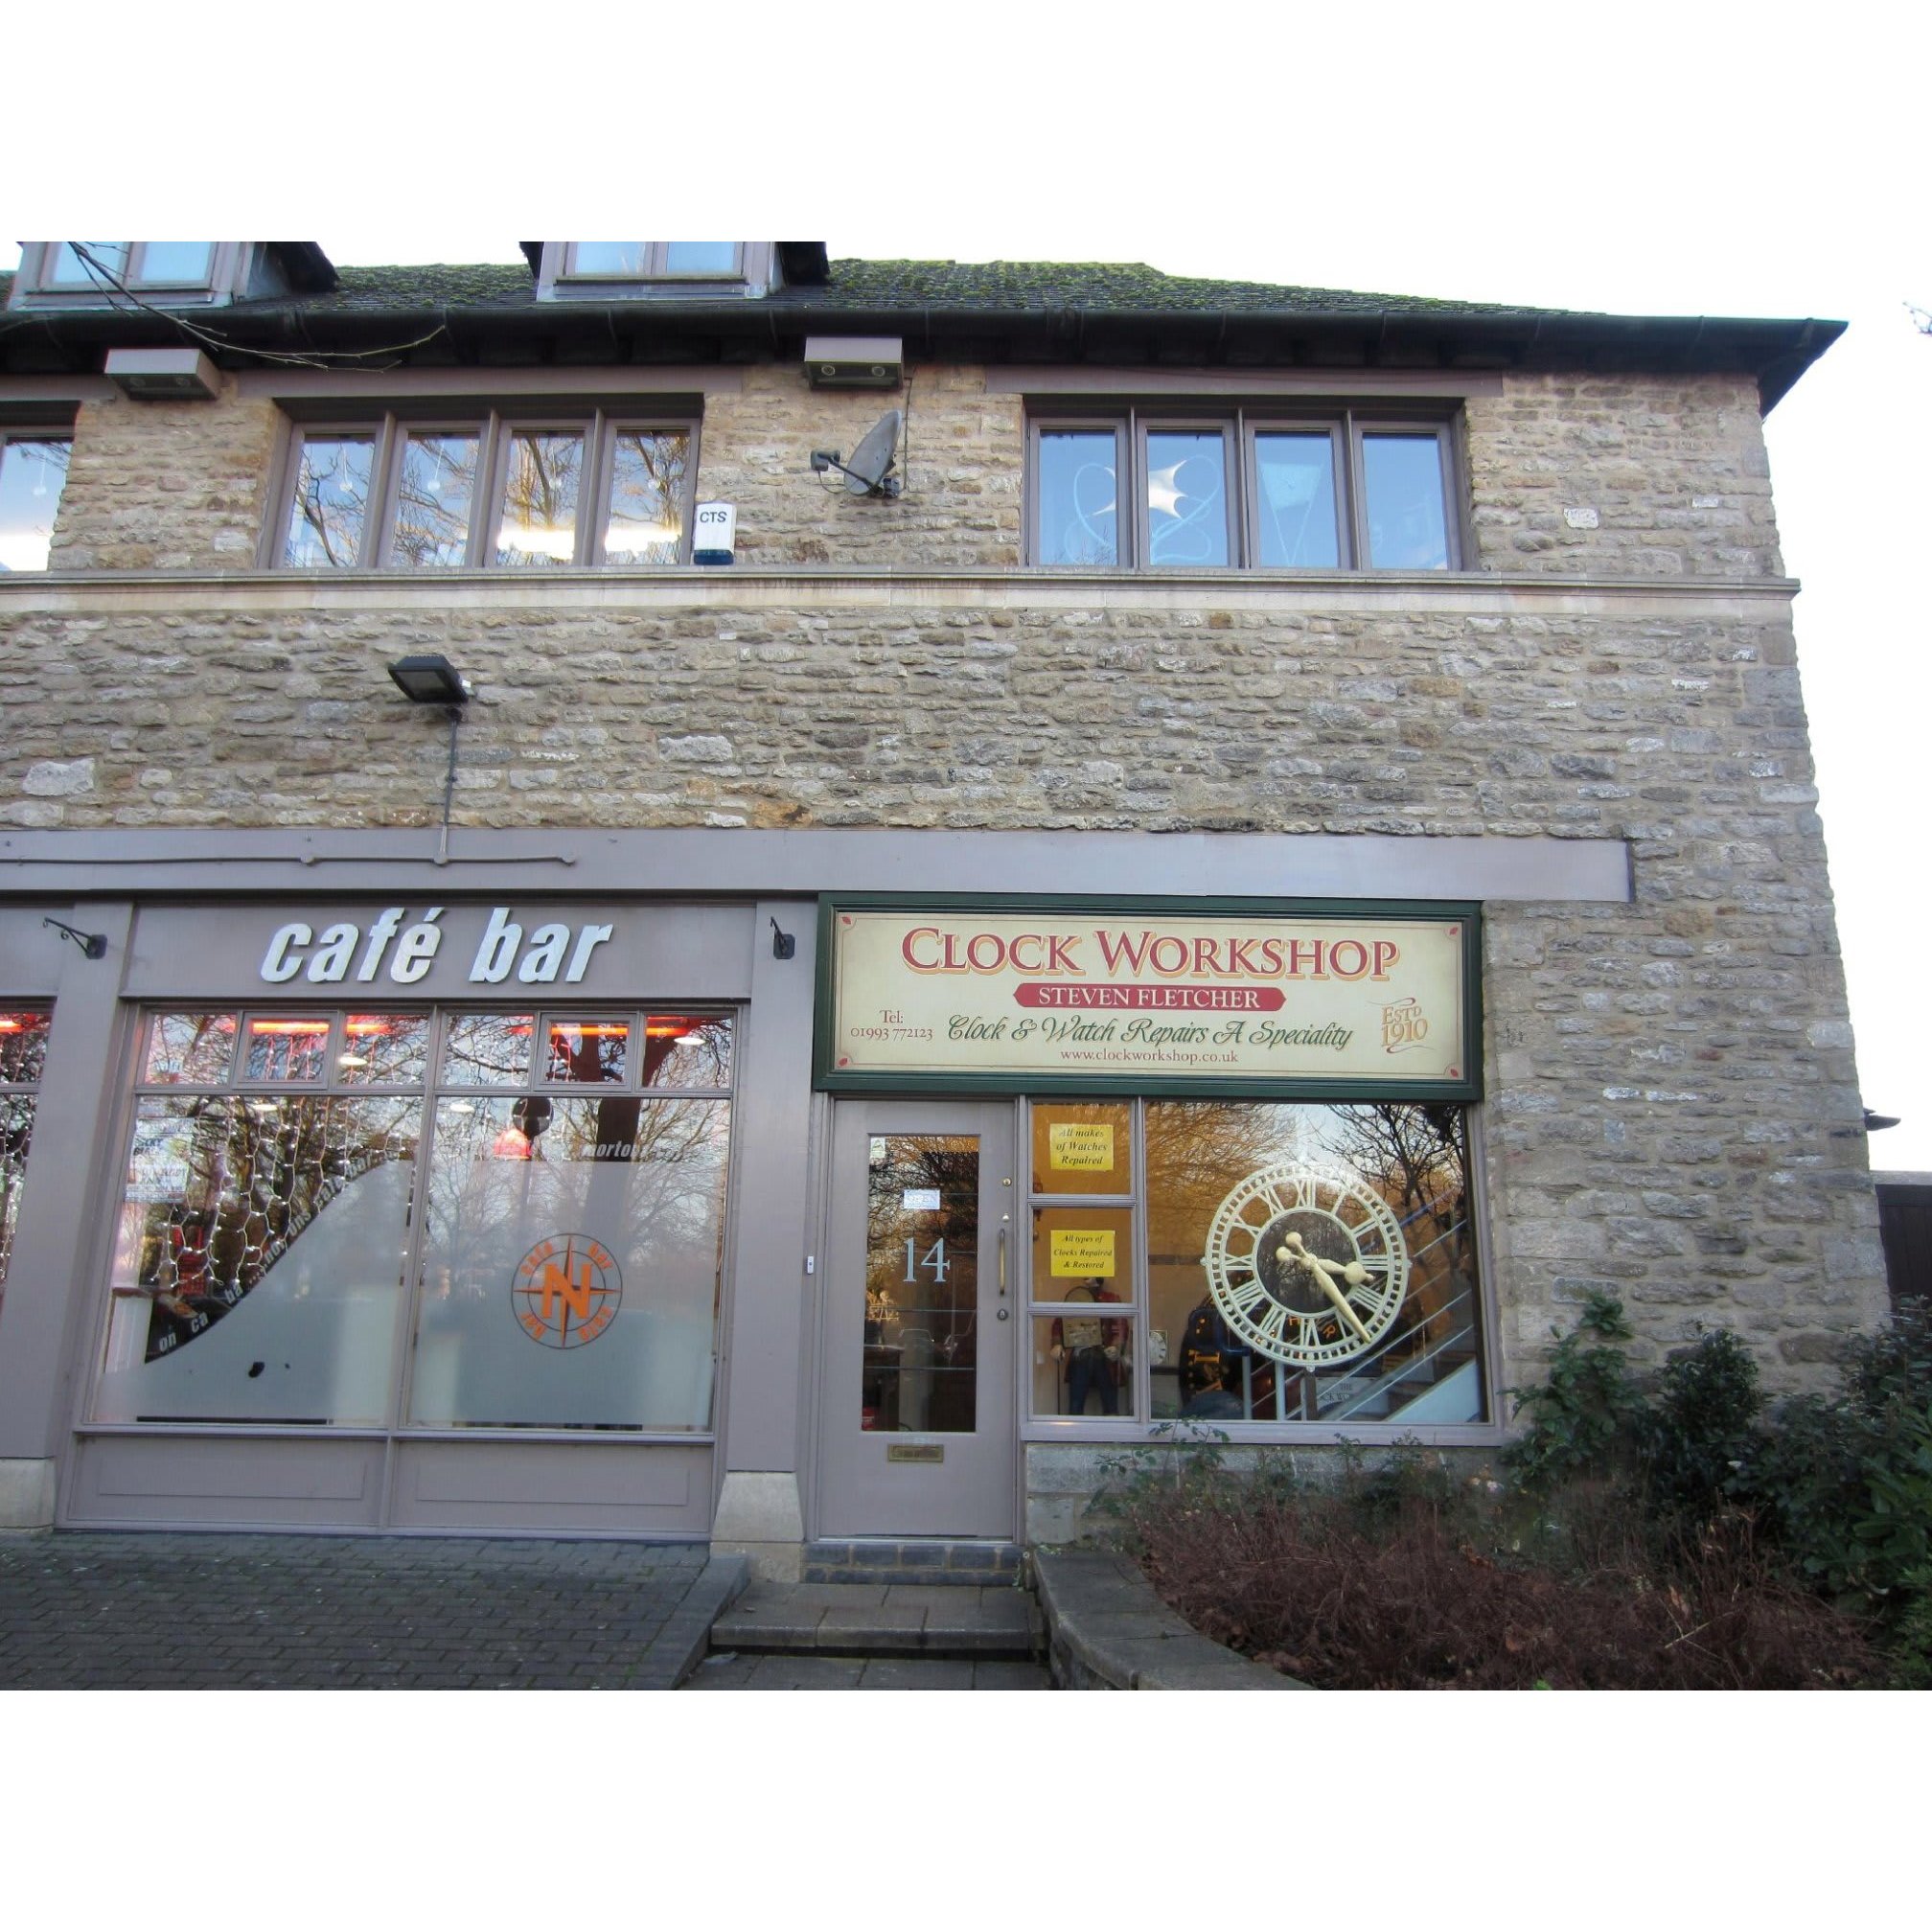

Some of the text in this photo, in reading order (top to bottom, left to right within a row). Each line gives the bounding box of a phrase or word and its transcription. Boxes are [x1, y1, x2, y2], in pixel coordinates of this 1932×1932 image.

[700, 511, 727, 523] CTS
[260, 907, 614, 983] café bar
[902, 927, 1399, 981] CLOCK WORKSHOP
[1039, 986, 1260, 1008] STEVEN FLETCHER
[880, 1010, 904, 1024] Tel:
[851, 1026, 933, 1042] 01993 772123
[947, 1014, 1354, 1052] Clock & Watch Repairs A Speciality
[1380, 1018, 1429, 1047] 1910
[1061, 1048, 1239, 1066] www.clockworkshop.co.uk
[1059, 1128, 1105, 1138] All makes
[1056, 1141, 1107, 1152] of Watches
[1061, 1156, 1103, 1166] Repaired
[1063, 1234, 1104, 1244] All types of
[903, 1237, 951, 1282] 14
[1054, 1248, 1113, 1258] Clocks Repaired
[1064, 1260, 1105, 1269] & Restored
[541, 1263, 592, 1319] N
